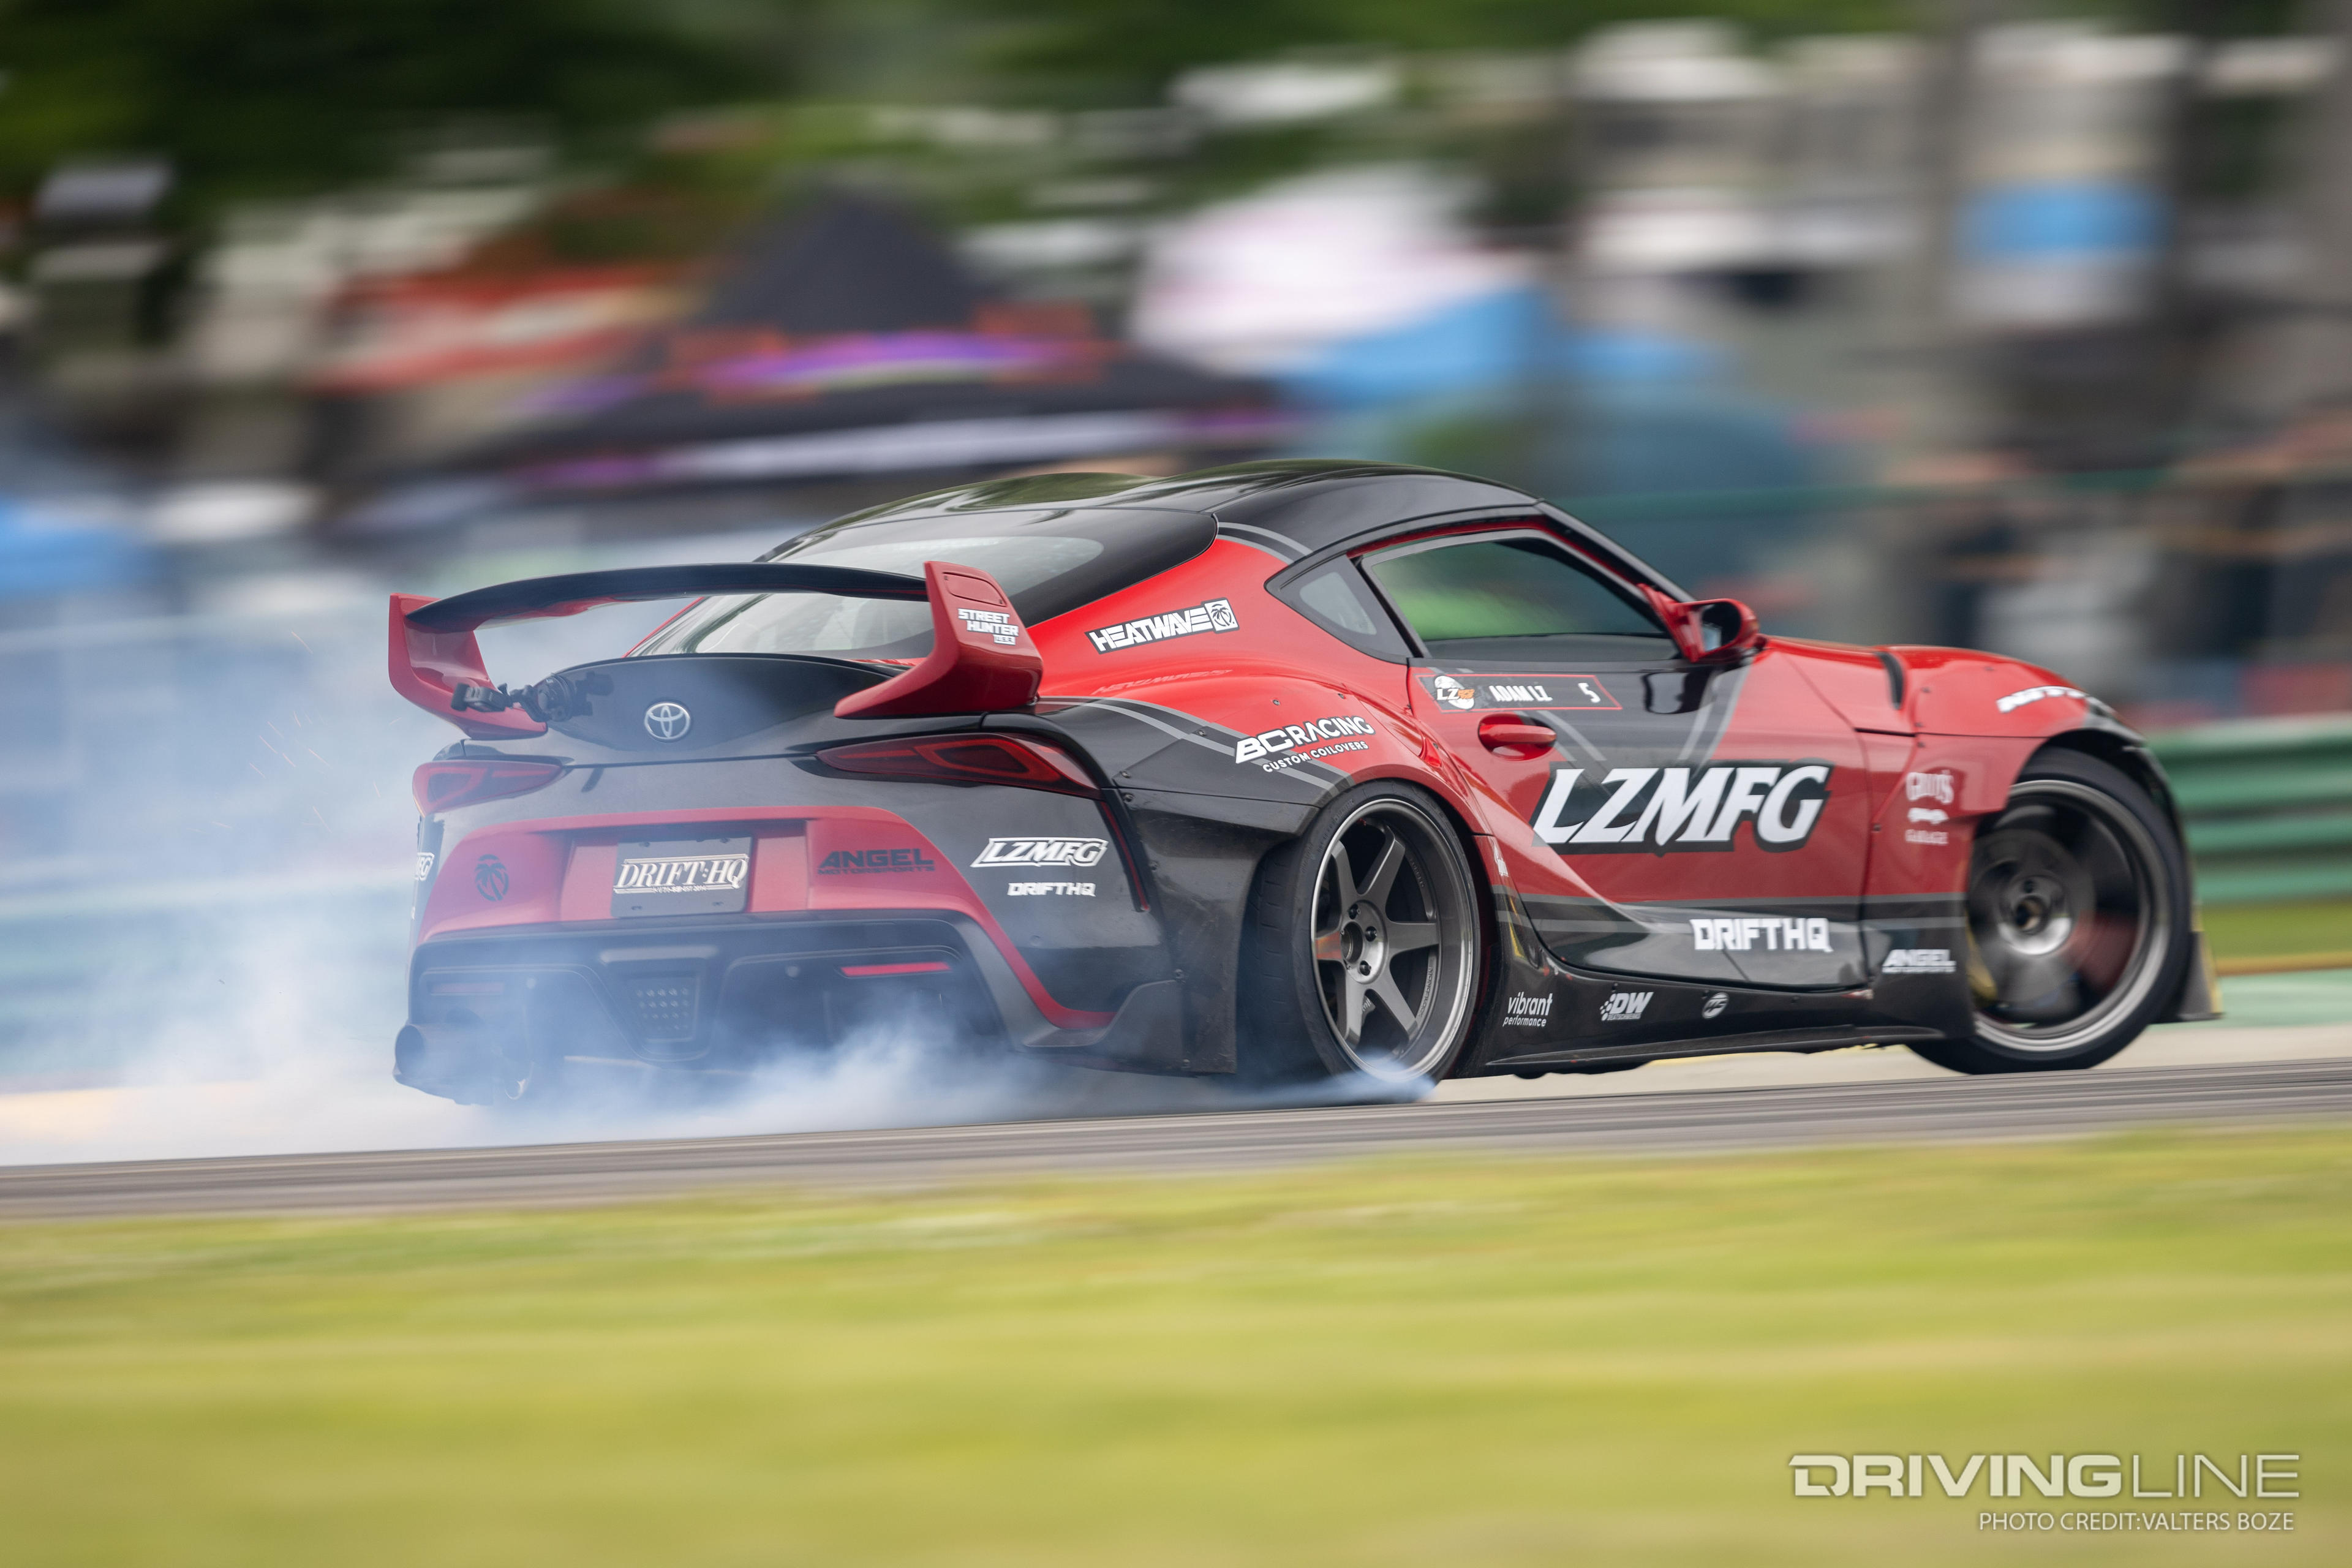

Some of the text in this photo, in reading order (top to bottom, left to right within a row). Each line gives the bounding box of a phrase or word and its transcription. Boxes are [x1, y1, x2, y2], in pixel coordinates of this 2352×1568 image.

[957, 608, 1010, 625] STREET
[966, 620, 1019, 637] HUNTER
[1088, 606, 1214, 652] HEATWAVE
[1527, 685, 1553, 702] LZ
[1578, 682, 1601, 704] 5
[1262, 740, 1369, 773] CUSTOM COILOVERS
[1532, 765, 1830, 847] LZMFG
[818, 848, 935, 868] ANGEL
[980, 840, 1102, 864] LZMFG
[818, 867, 935, 875] MOTORSPORTS
[1689, 918, 1834, 953] DRIFTHQ
[1507, 991, 1553, 1016] vibrant
[1608, 991, 1654, 1014] DW
[1502, 1014, 1547, 1028] performance
